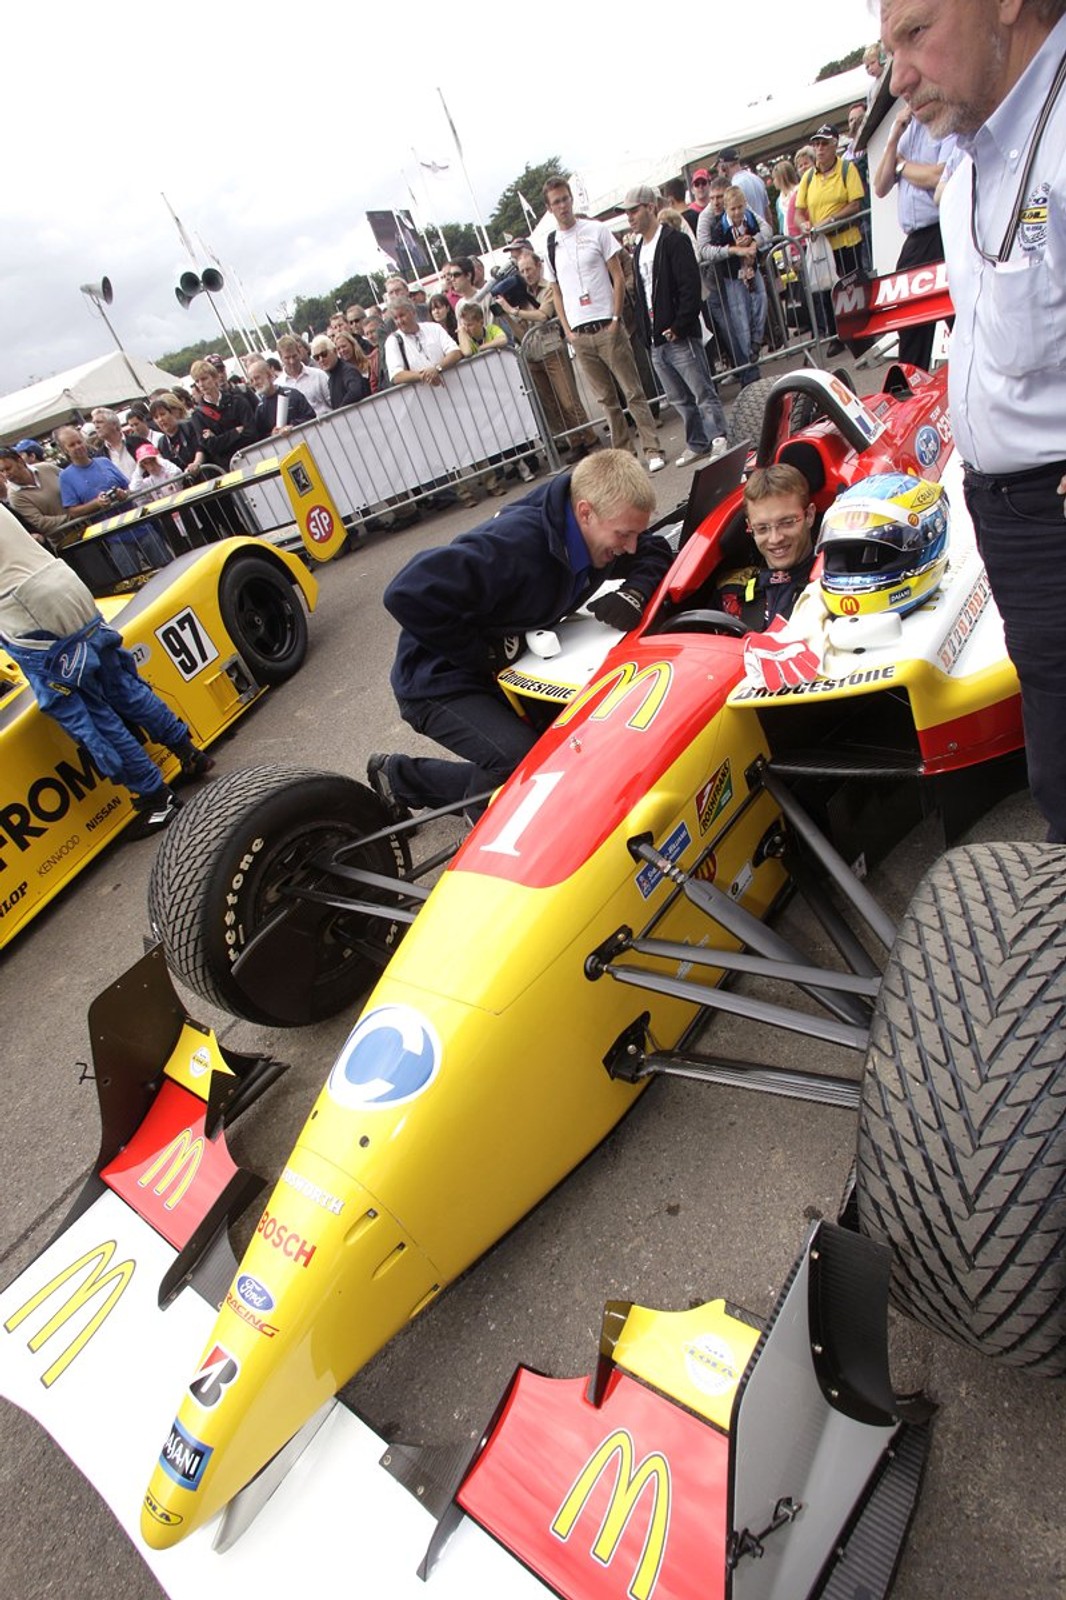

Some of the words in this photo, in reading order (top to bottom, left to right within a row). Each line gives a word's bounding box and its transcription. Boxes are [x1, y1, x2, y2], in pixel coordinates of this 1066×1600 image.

[309, 507, 331, 541] STP
[161, 611, 208, 675] 97
[86, 796, 122, 832] NISSAN
[481, 771, 566, 858] 1
[37, 834, 80, 878] KENWOOD
[257, 1211, 317, 1269] BOSCH
[224, 1292, 280, 1338] RACING
[239, 1278, 268, 1310] Ford
[163, 1431, 201, 1477] ASANI
